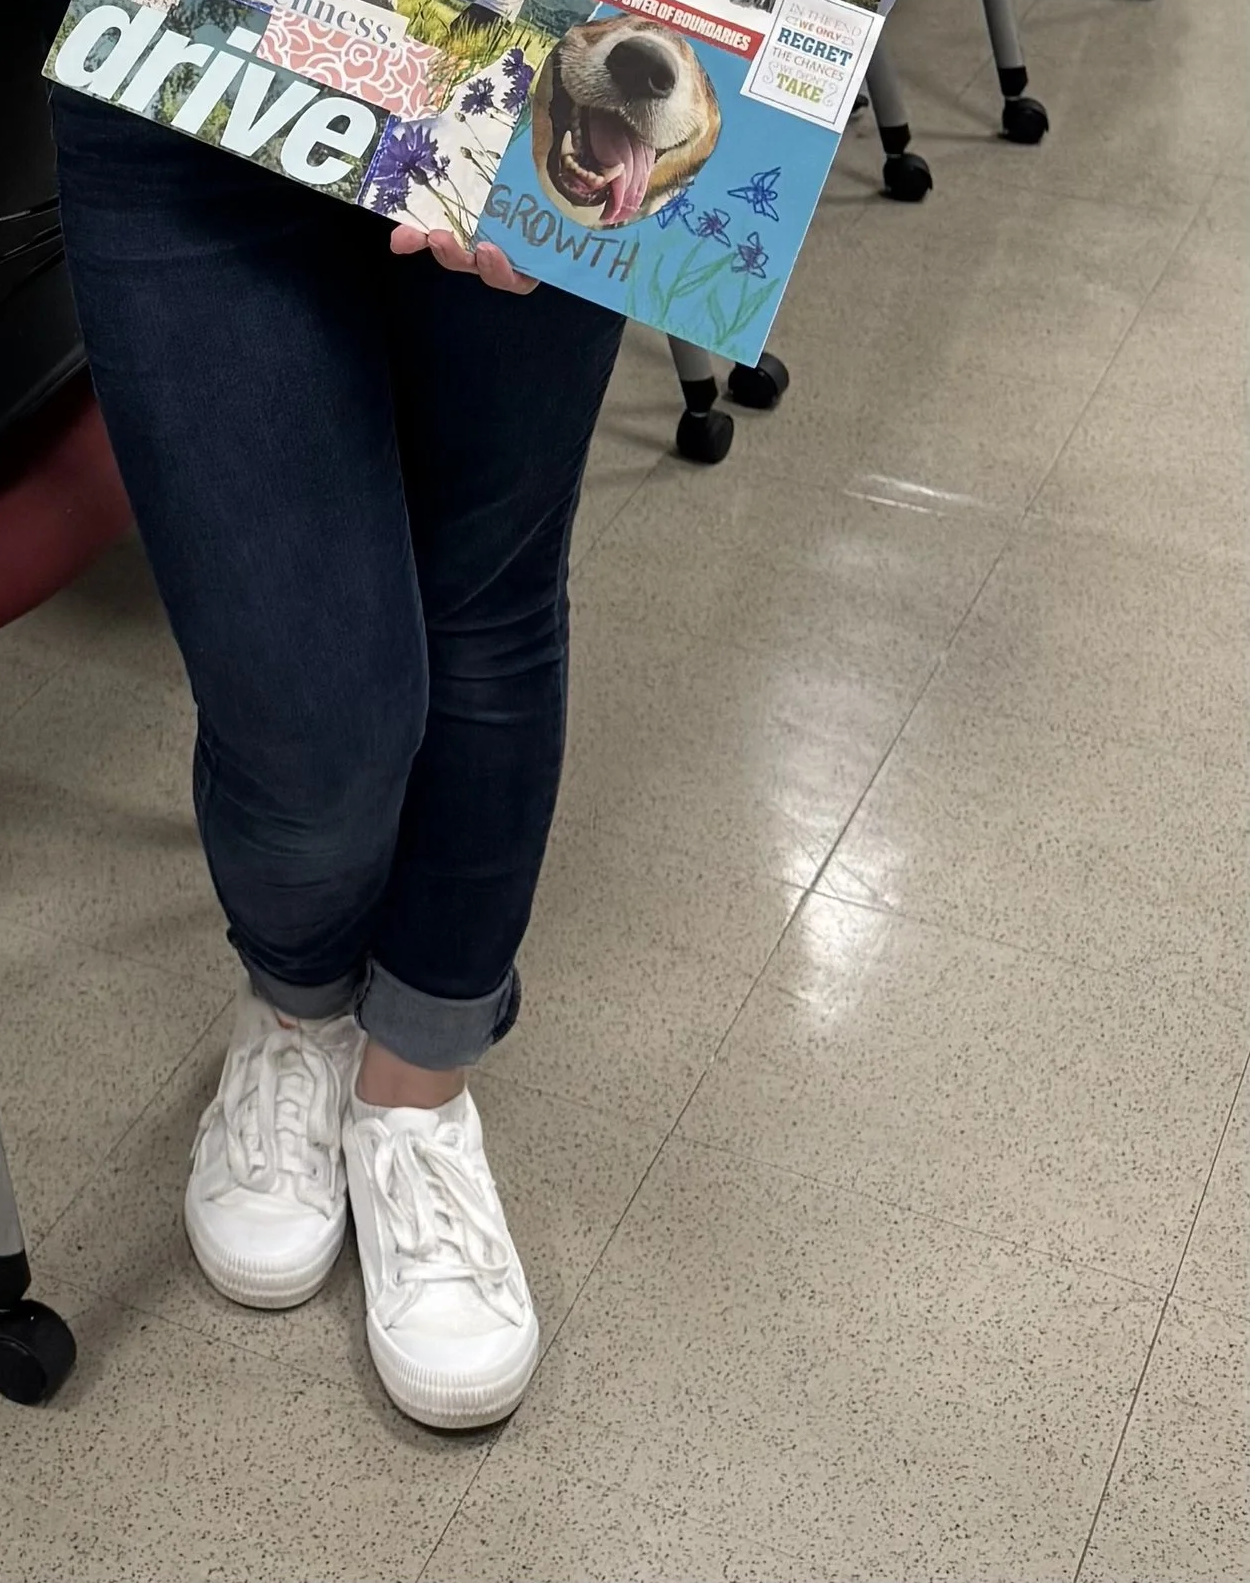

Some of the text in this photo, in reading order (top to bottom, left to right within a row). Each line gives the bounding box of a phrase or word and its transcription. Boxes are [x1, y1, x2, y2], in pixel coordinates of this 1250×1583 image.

[657, 2, 677, 22] OF
[672, 8, 752, 52] BOUNDARIES
[790, 2, 862, 37] IN THE END
[799, 20, 842, 42] WE ONLY
[772, 47, 845, 82] THE CHANCES
[777, 27, 853, 66] REGRET
[54, 5, 377, 185] drive
[776, 73, 824, 103] TAKE
[484, 183, 640, 282] GROWTH
